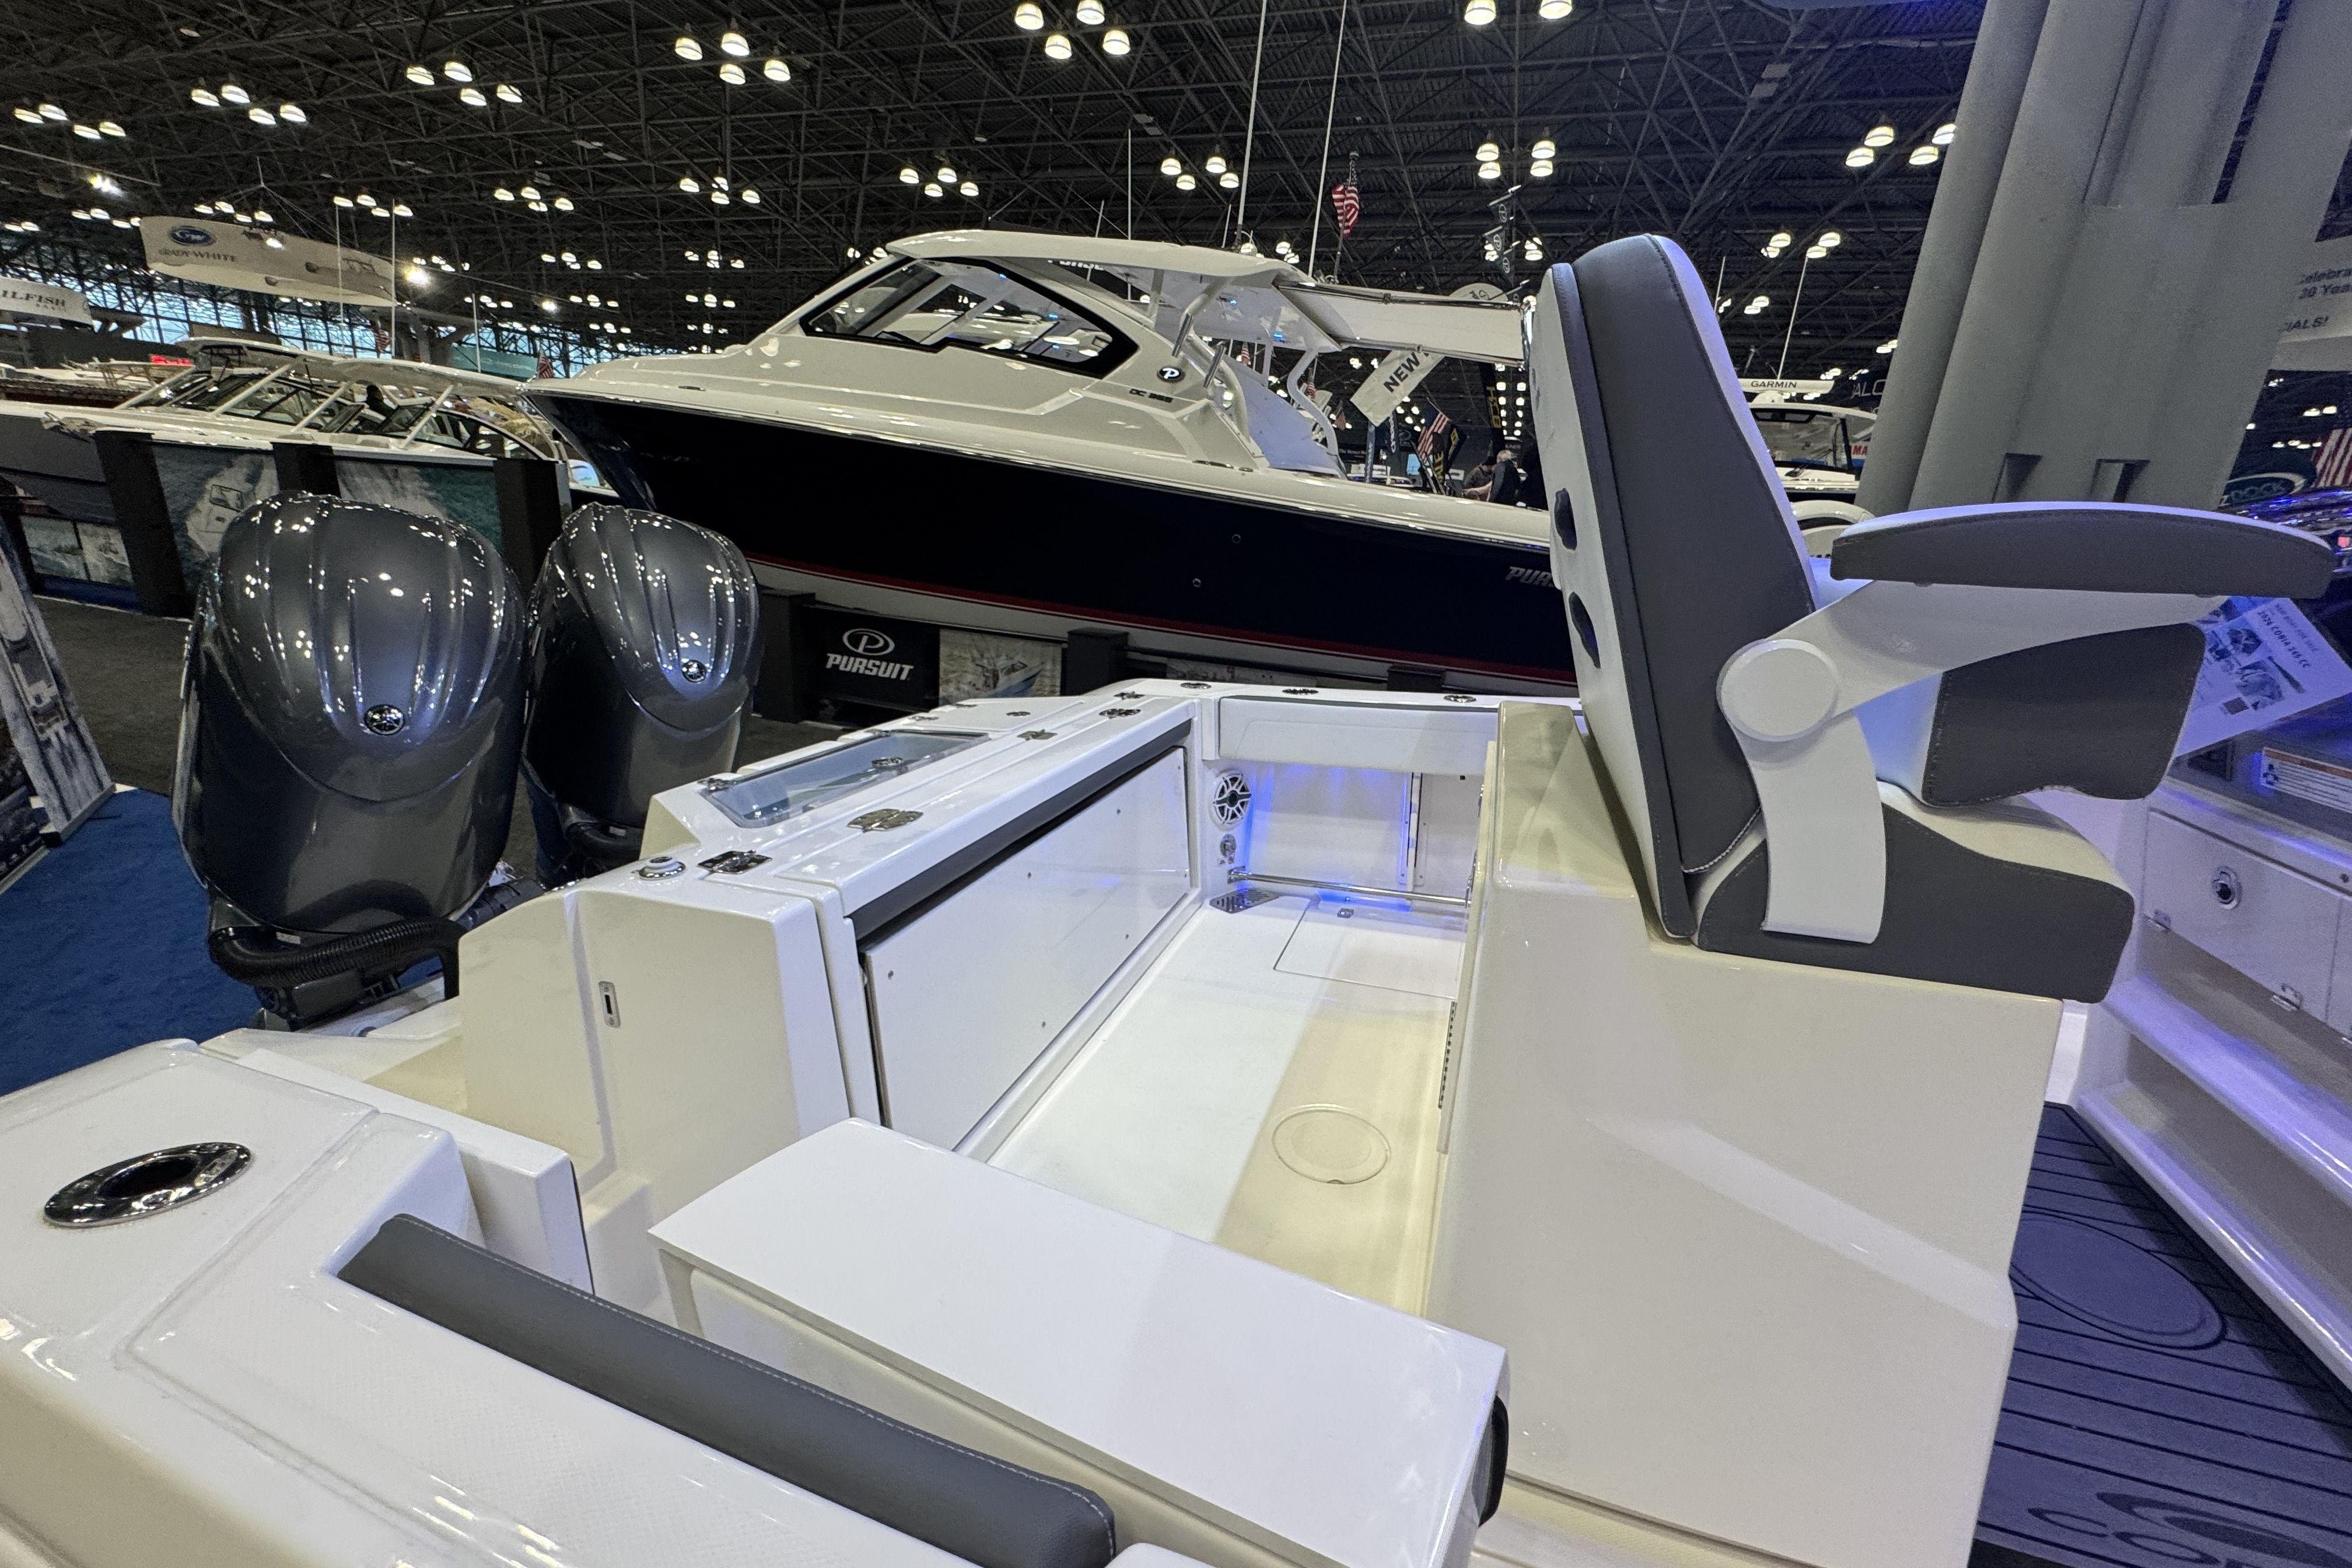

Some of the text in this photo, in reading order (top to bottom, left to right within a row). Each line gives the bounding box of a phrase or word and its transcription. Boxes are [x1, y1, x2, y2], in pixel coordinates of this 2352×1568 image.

[1383, 352, 1420, 393] NEW
[1751, 380, 1797, 388] GARMIN
[825, 653, 914, 681] PURSUIT
